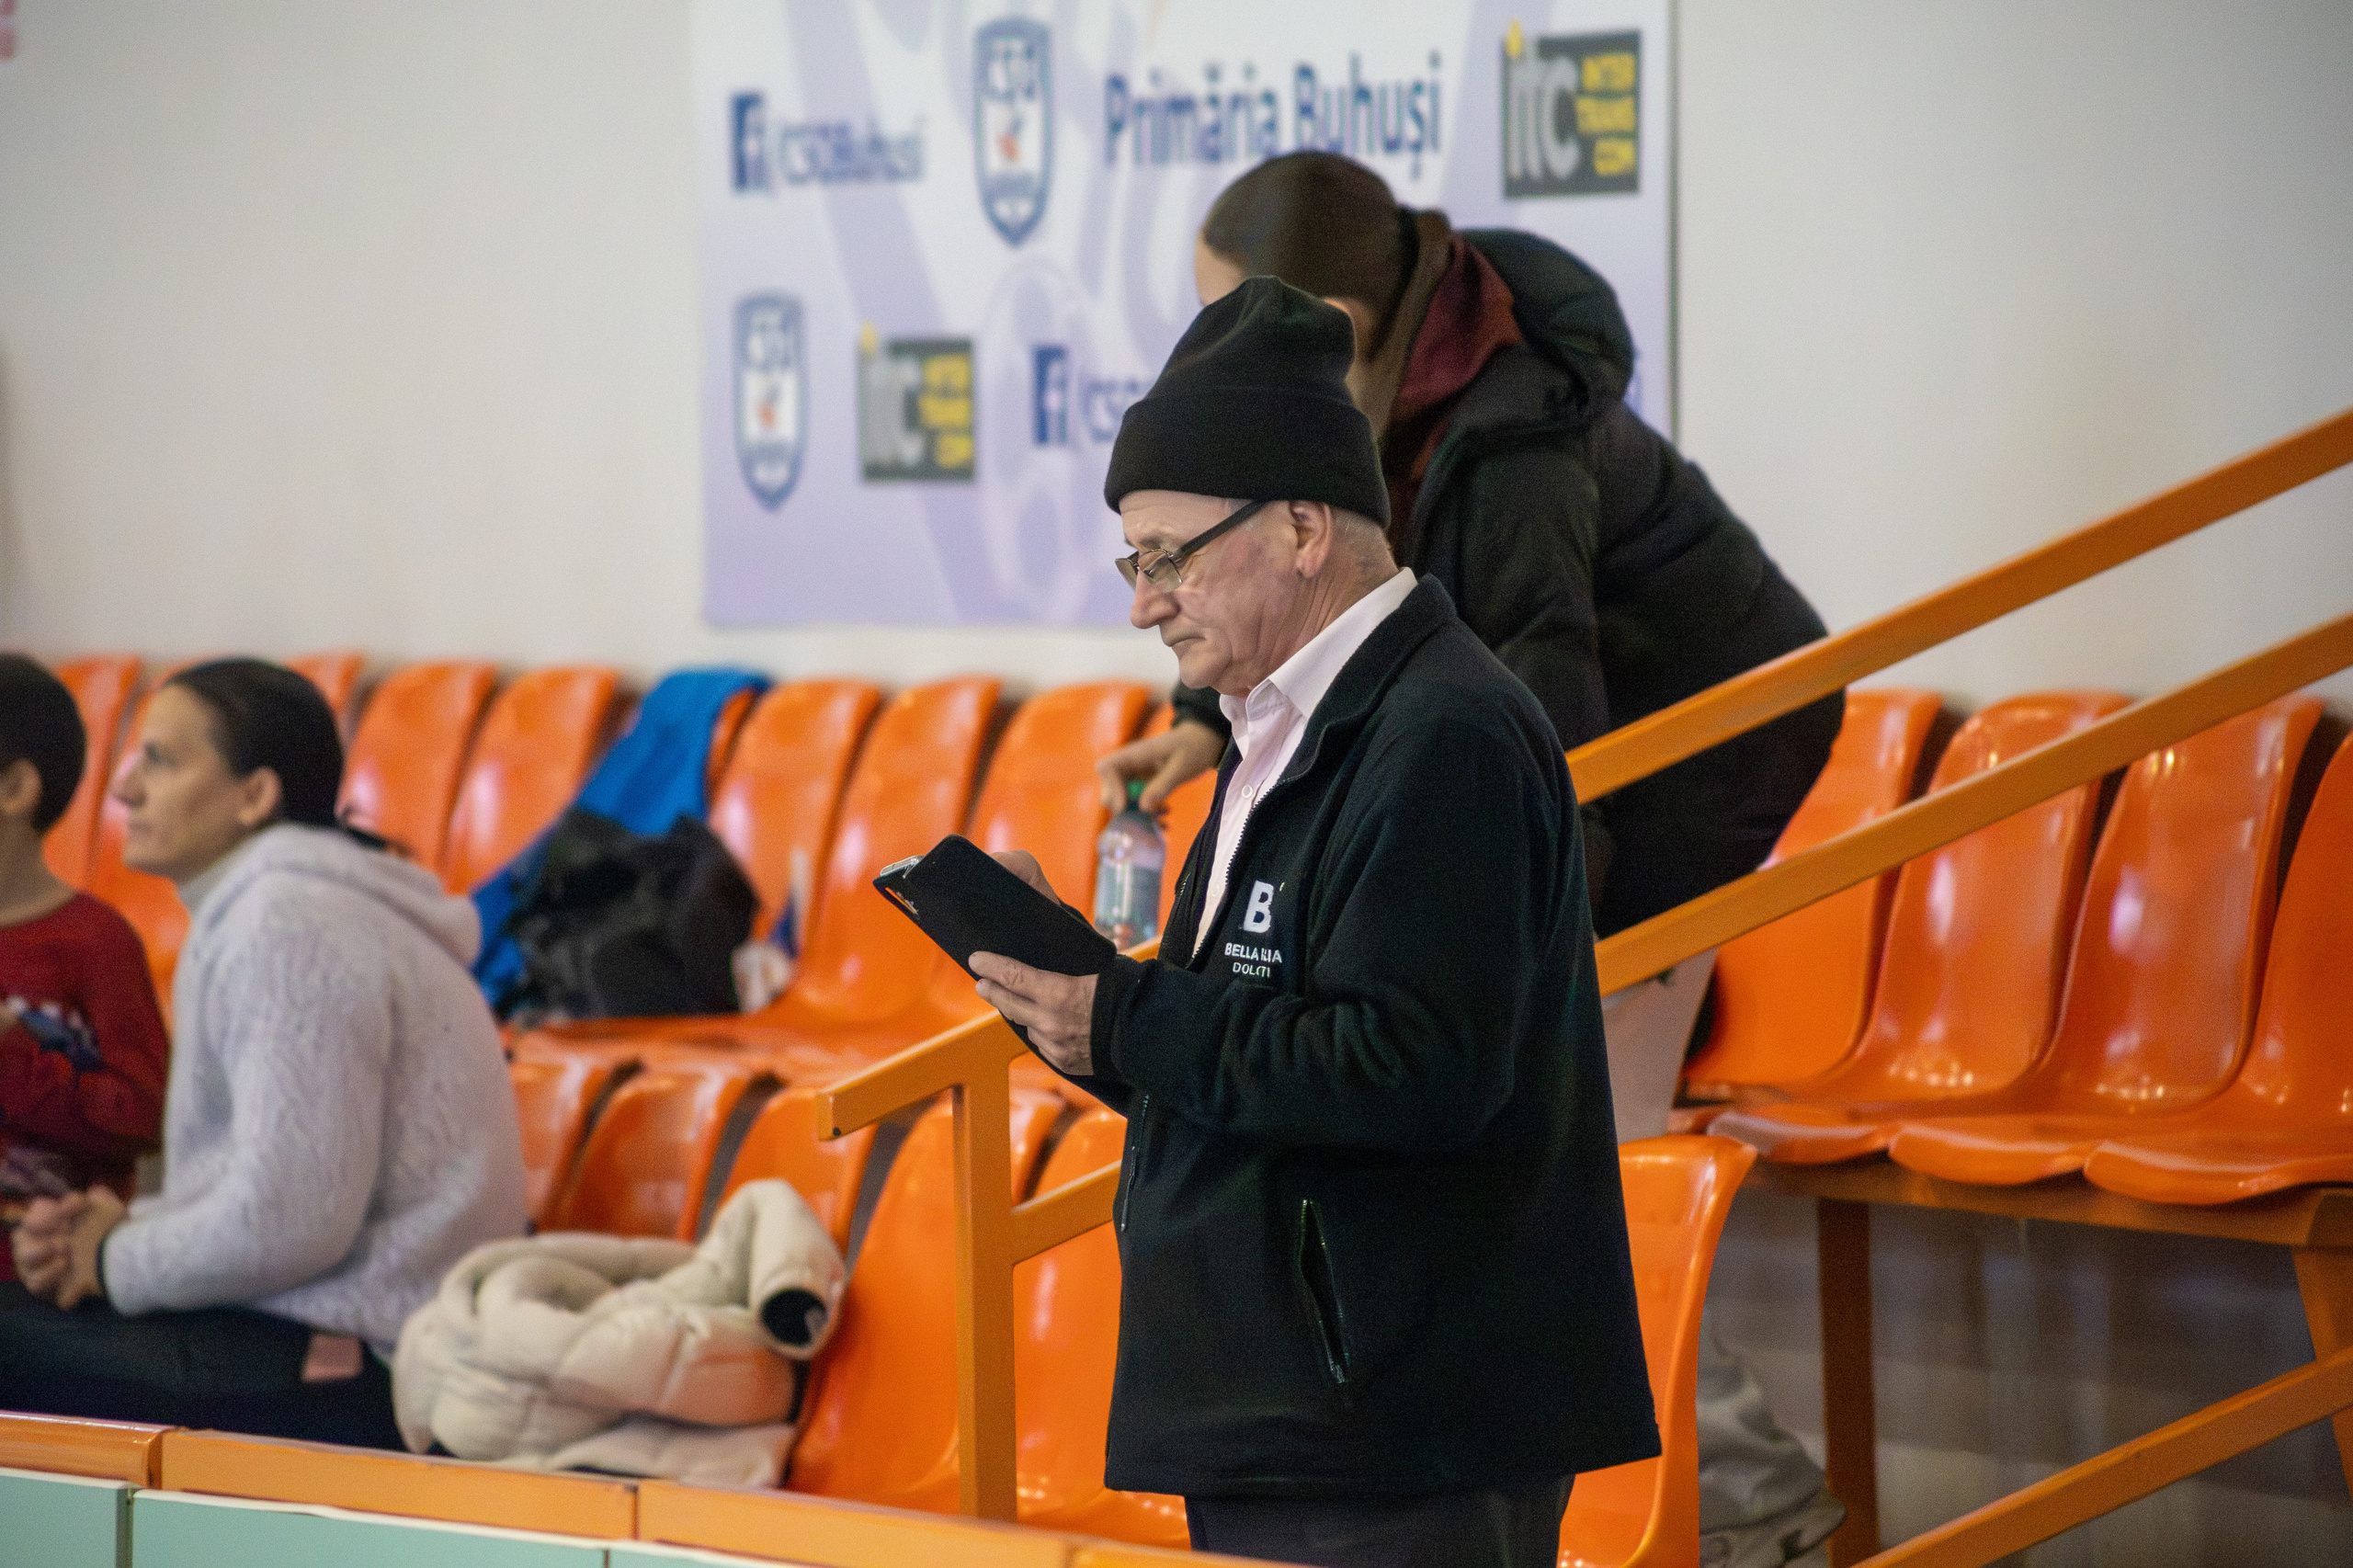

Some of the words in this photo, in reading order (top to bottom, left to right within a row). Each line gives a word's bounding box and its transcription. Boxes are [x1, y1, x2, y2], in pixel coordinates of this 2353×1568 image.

[1106, 59, 1278, 165] Primăria
[1294, 51, 1443, 180] Buhuși
[1244, 880, 1275, 934] B
[1224, 942, 1258, 961] BELLA
